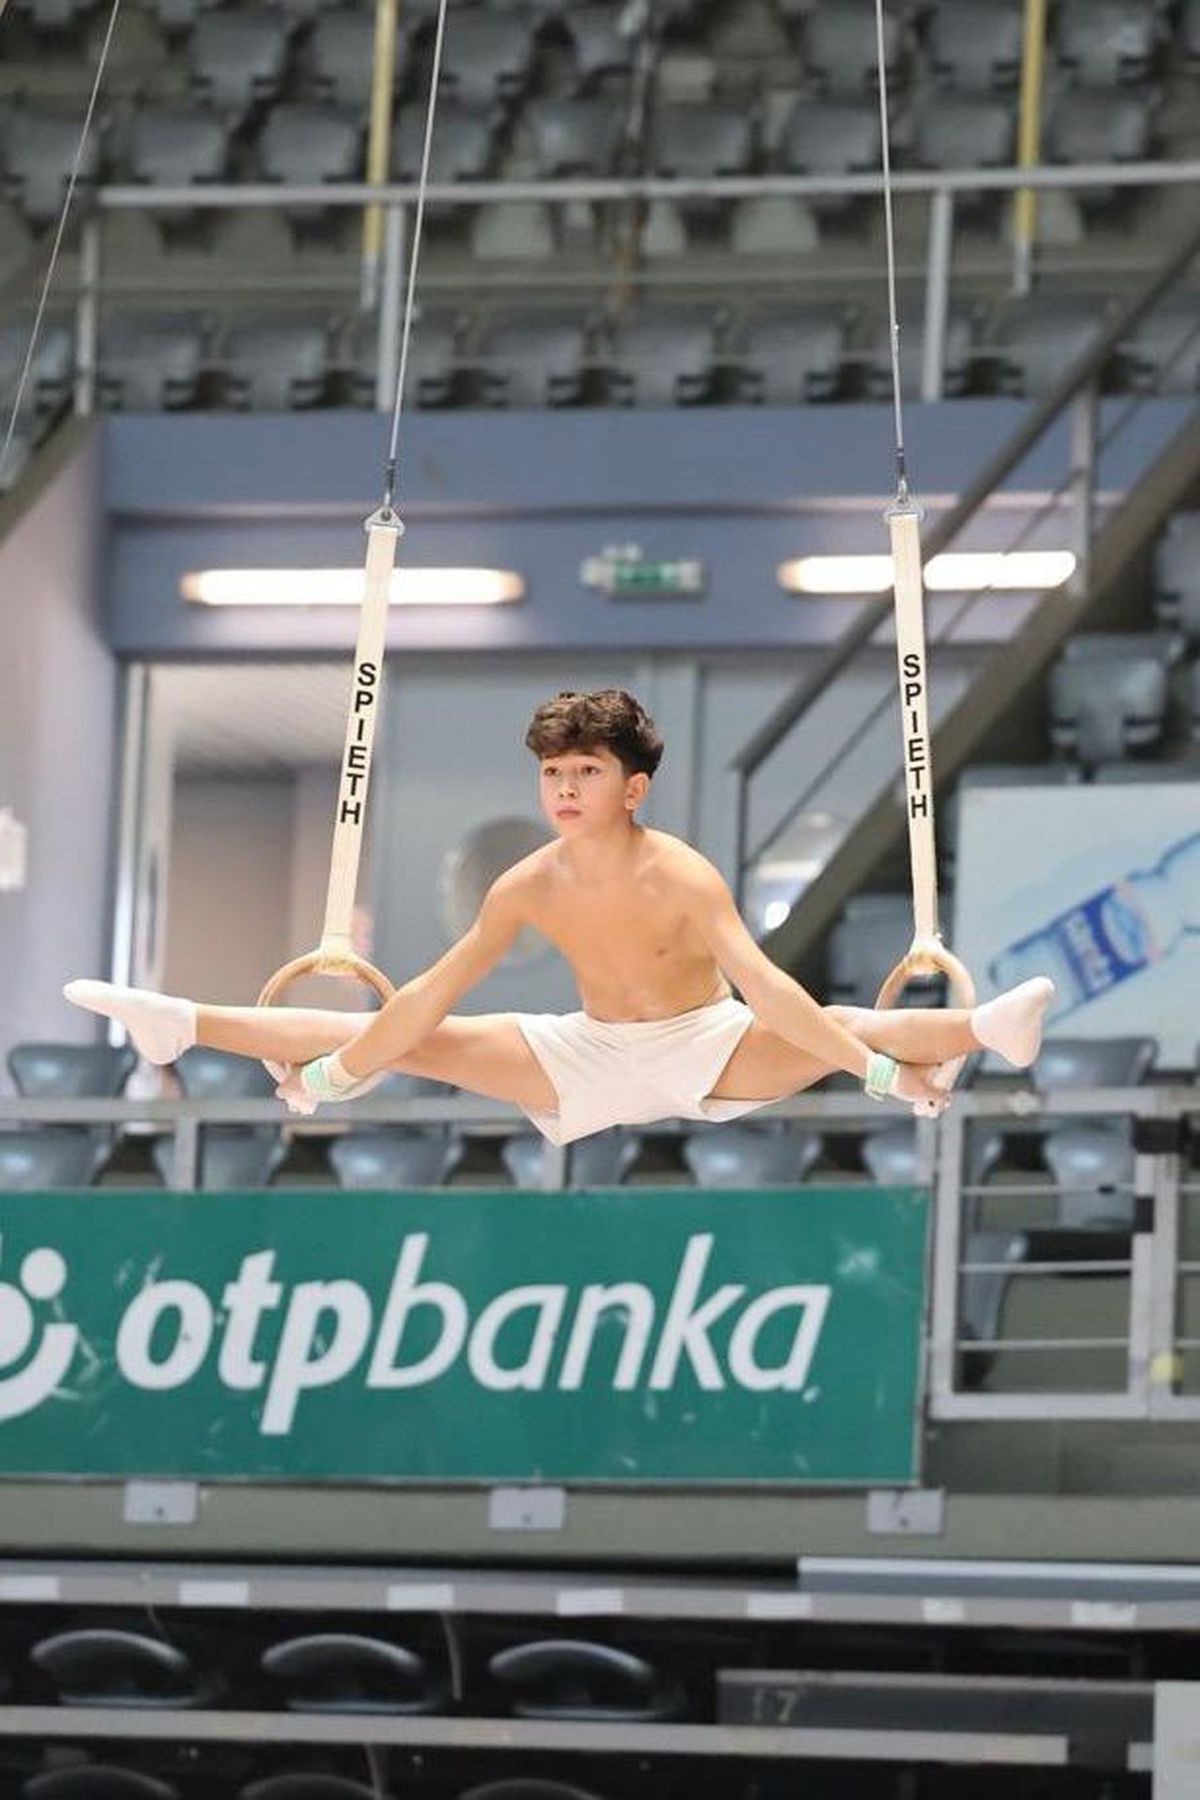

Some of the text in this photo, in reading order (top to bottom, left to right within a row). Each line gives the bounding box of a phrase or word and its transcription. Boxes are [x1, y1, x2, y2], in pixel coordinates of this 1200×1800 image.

[339, 662, 377, 825] SPIETH
[903, 653, 928, 819] SPIETH
[115, 1232, 832, 1435] otpbanka
